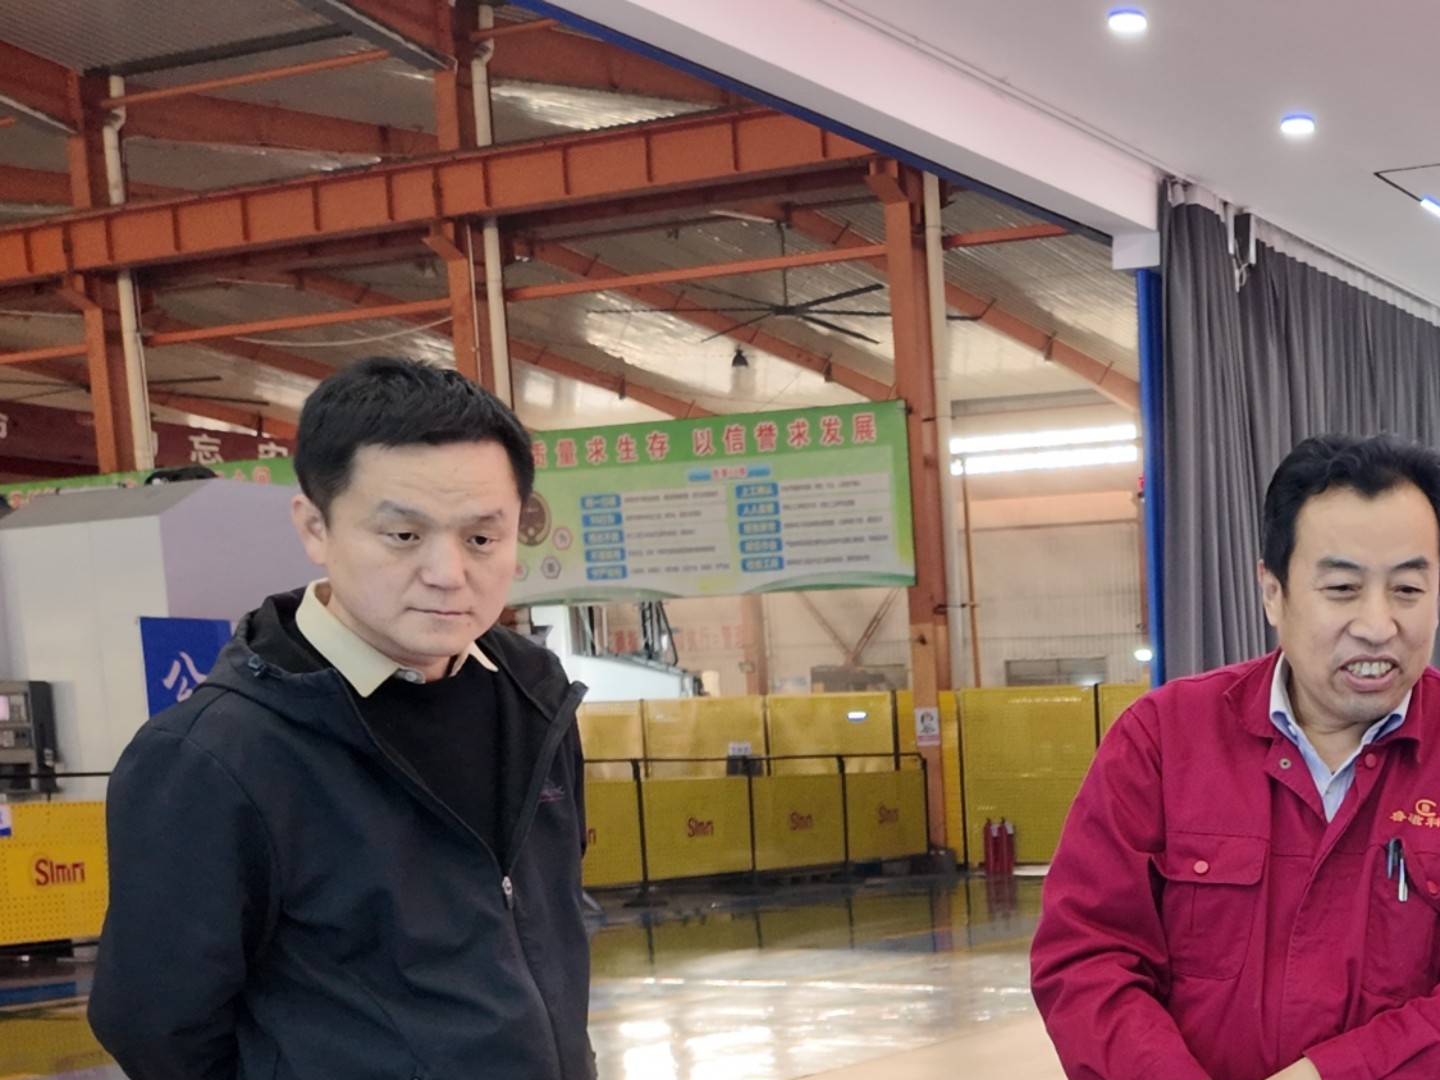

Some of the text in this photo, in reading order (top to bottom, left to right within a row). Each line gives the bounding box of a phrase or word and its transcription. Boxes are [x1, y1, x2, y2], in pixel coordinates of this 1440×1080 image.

[692, 413, 878, 456] 以信誉求发展
